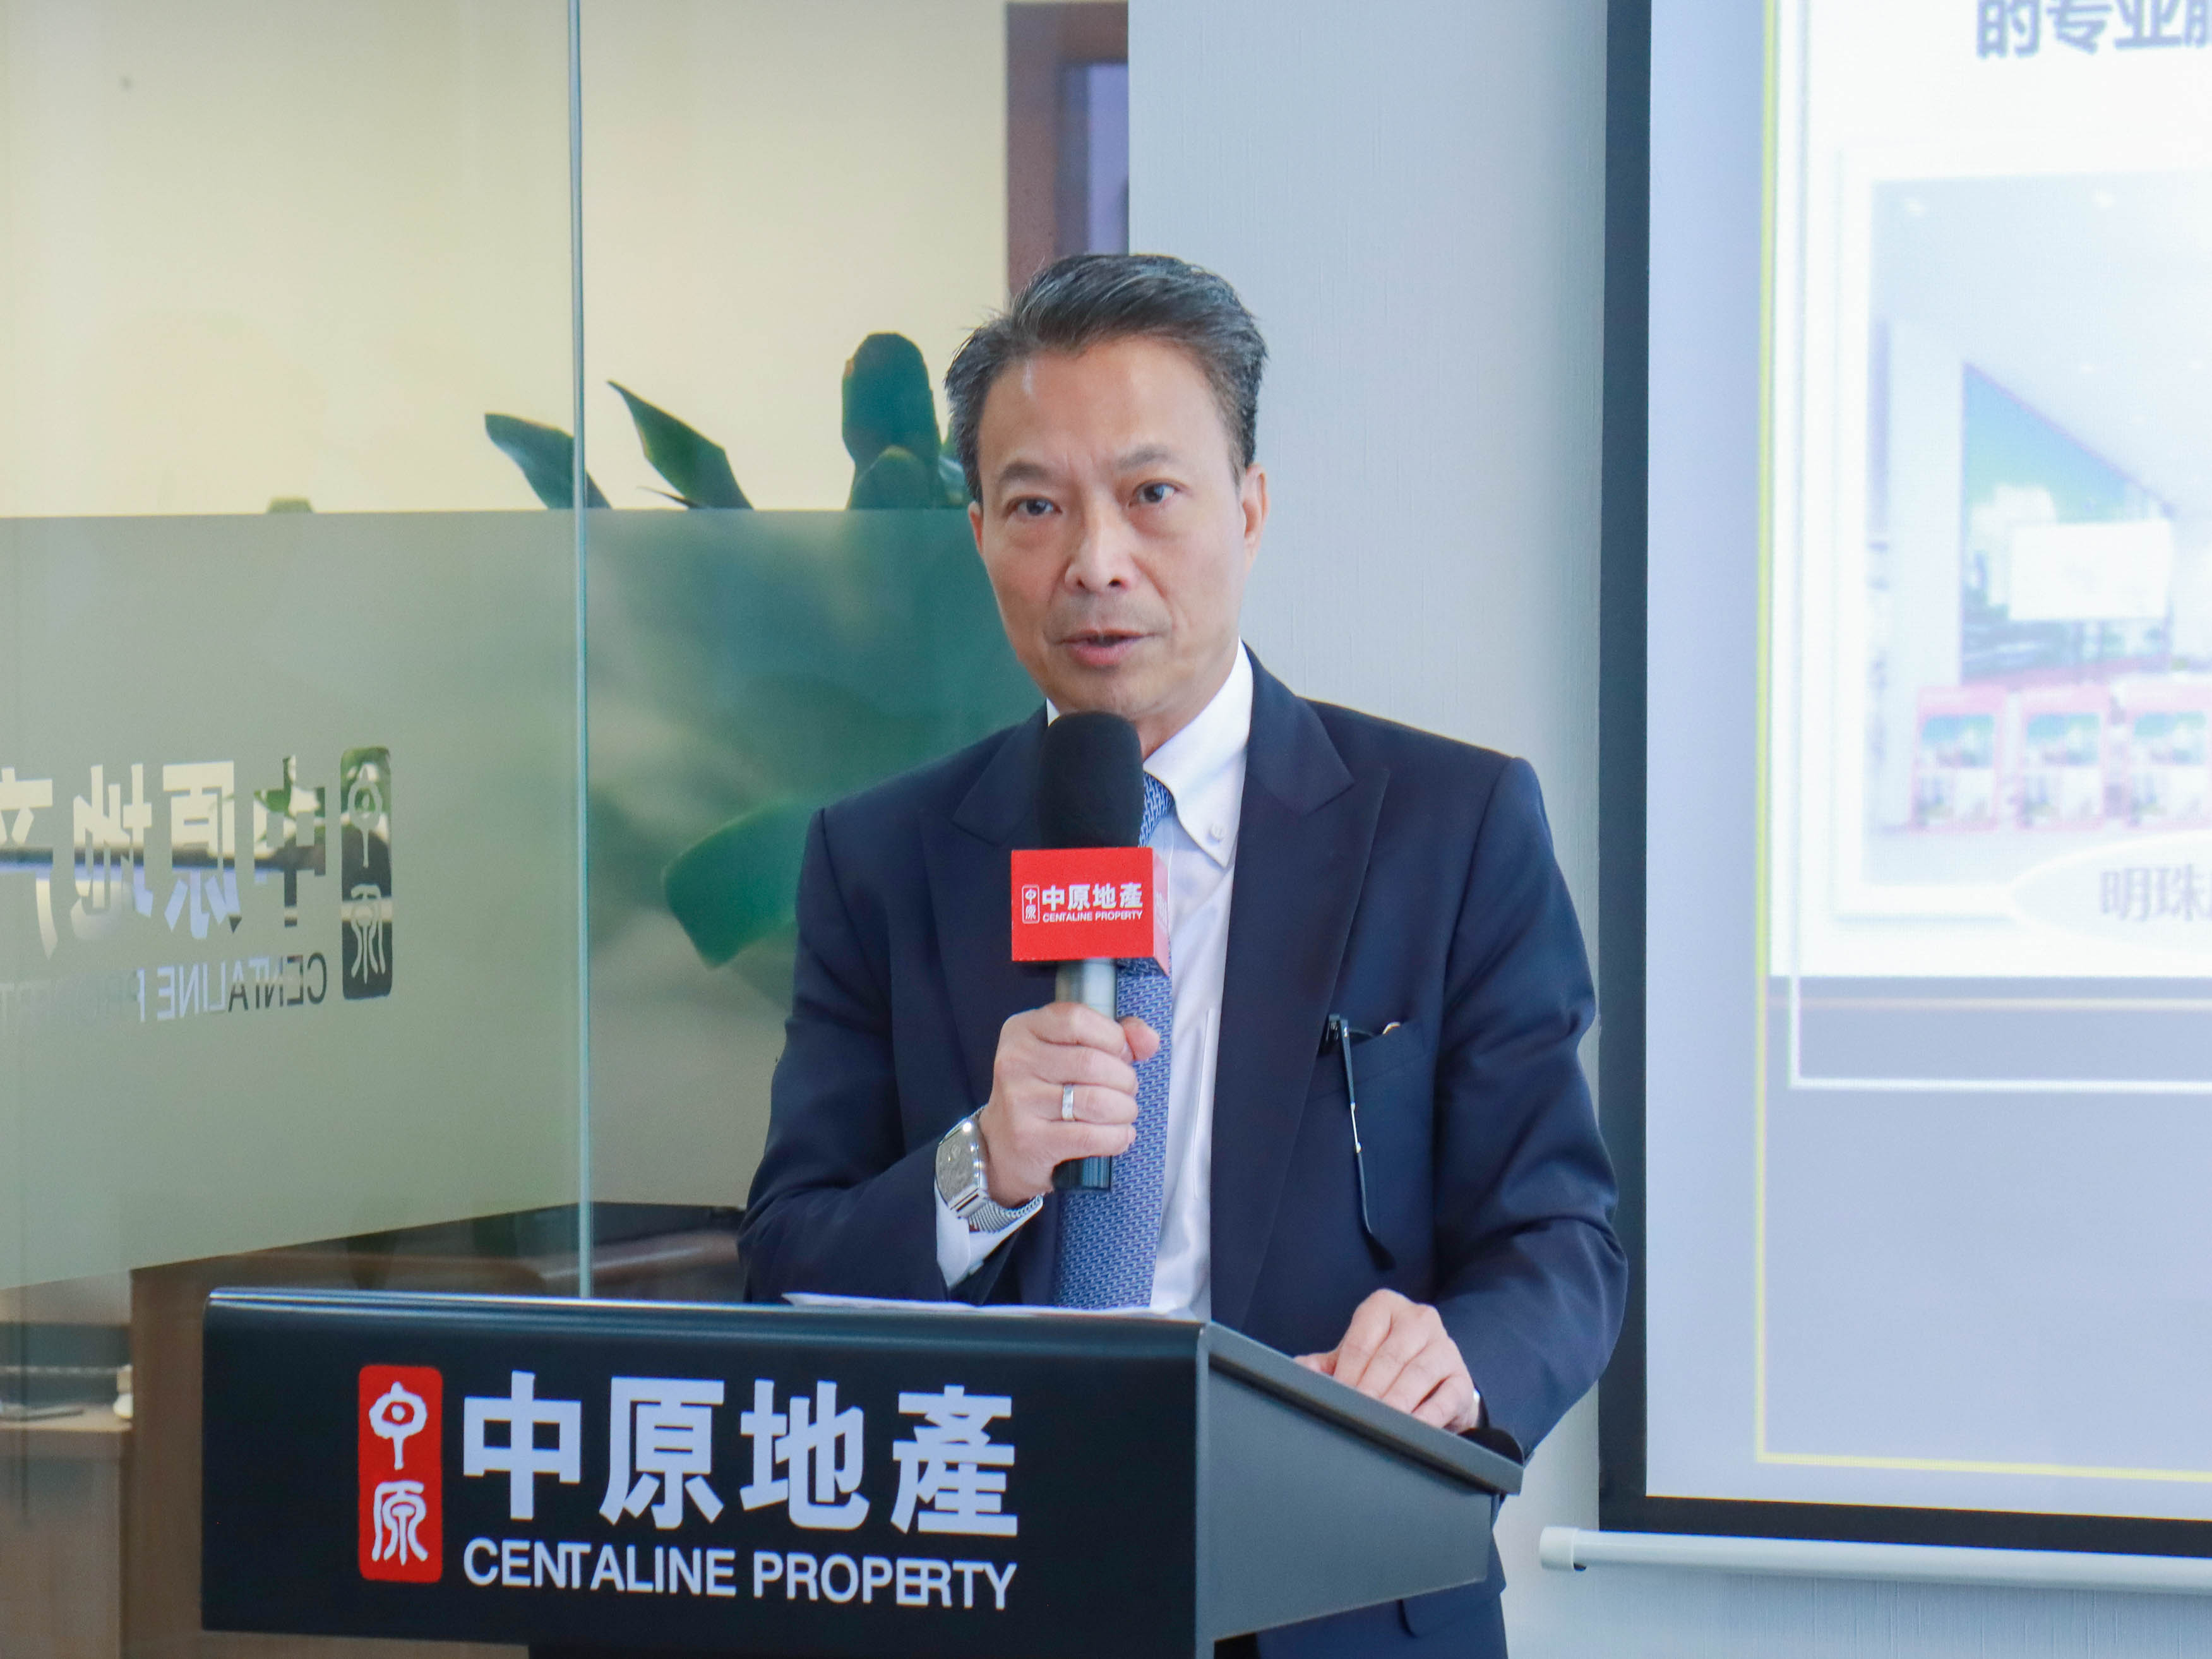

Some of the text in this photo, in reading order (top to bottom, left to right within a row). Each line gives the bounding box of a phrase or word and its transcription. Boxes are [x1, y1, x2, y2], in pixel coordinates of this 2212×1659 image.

[1043, 882, 1143, 911] 中原地產
[1043, 910, 1142, 923] CENTALINE PROPERTY
[2099, 863, 2212, 922] 明珠
[463, 1370, 1017, 1536] 中原地產
[463, 1537, 1018, 1610] CENTALINE PROPERTY
